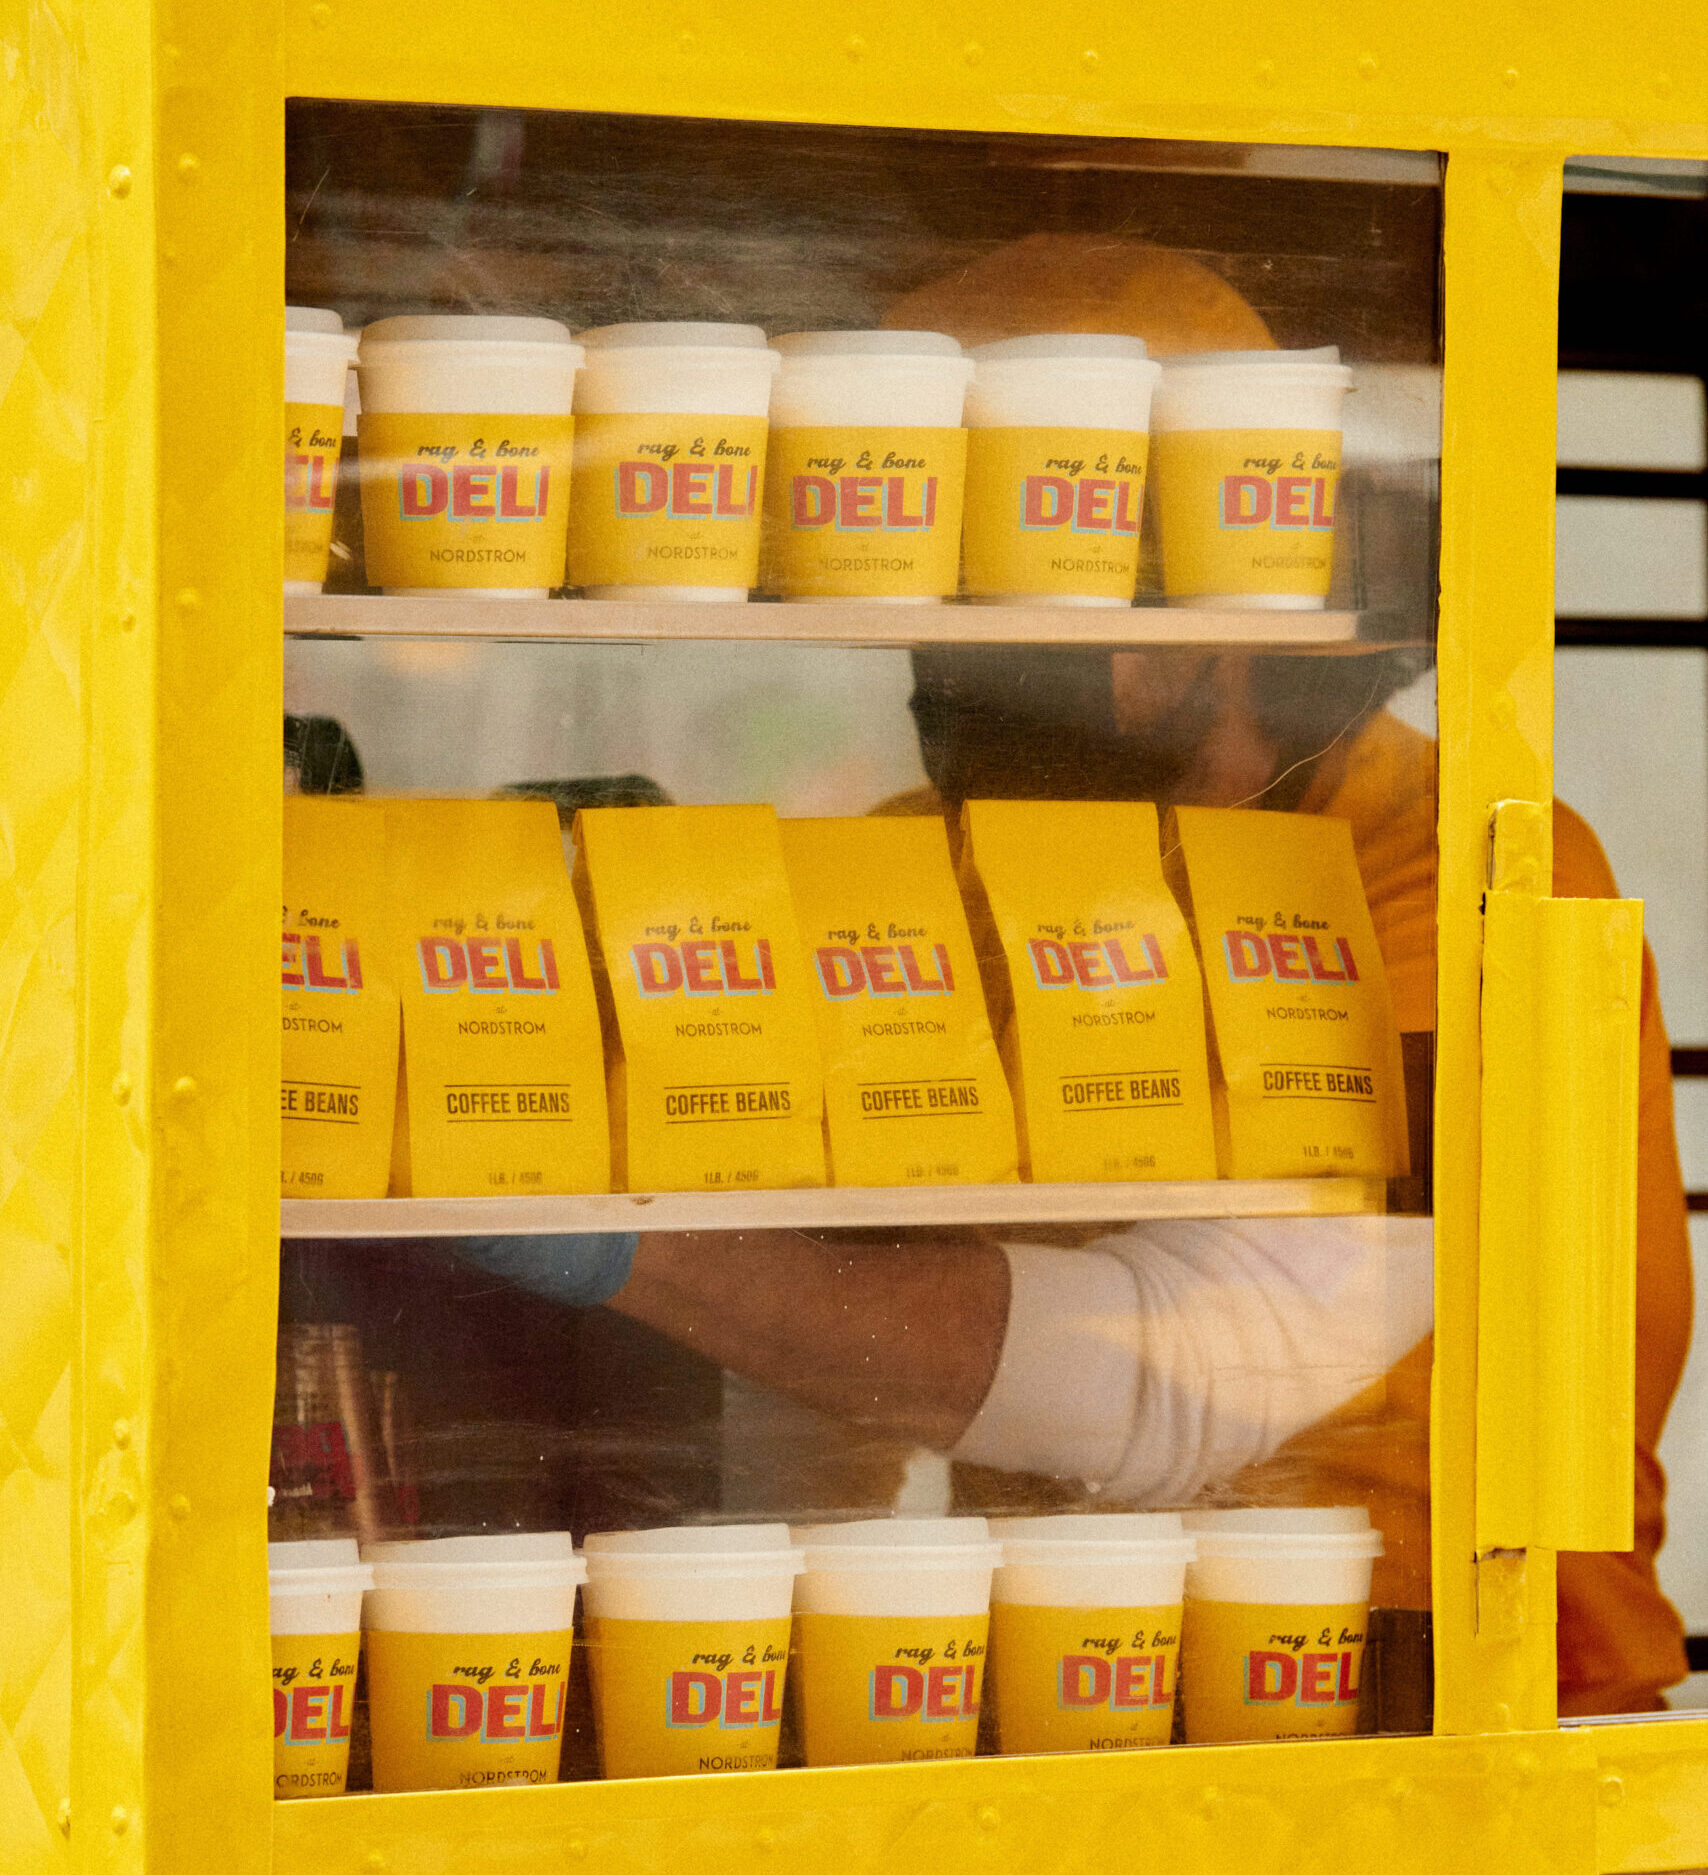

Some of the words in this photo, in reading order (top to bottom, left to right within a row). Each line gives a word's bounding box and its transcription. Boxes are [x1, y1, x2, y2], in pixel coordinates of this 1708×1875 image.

[416, 443, 458, 464] rag
[468, 437, 487, 459] &
[495, 439, 539, 458] bone
[636, 443, 680, 462] rag
[688, 436, 706, 458] &
[806, 456, 847, 476] rag
[855, 450, 873, 470] &
[881, 451, 927, 470] bone
[1045, 457, 1087, 477] rag
[1094, 453, 1109, 474] &
[1242, 456, 1283, 476] rag
[1291, 451, 1306, 471] &
[284, 454, 340, 514] EL
[398, 463, 551, 523] DELI
[614, 461, 758, 520] DELI
[790, 475, 938, 532] DELI
[1019, 475, 1143, 538] DEL
[1218, 475, 1341, 532] DEL
[430, 549, 526, 563] NORDSTROM
[647, 545, 739, 560] NORDSTROM
[1050, 558, 1130, 574] NORDSTROM
[298, 908, 340, 929] bone
[432, 917, 467, 936] rag
[475, 912, 489, 931] &
[496, 913, 536, 931] bone
[643, 924, 681, 942] rag
[688, 916, 703, 936] &
[710, 915, 752, 933] bone
[1036, 923, 1067, 941] rag
[1092, 917, 1135, 936] bone
[1235, 914, 1268, 932] rag
[1273, 911, 1287, 930] &
[1292, 913, 1330, 931] bone
[826, 929, 861, 946] rag
[866, 922, 881, 941] &
[886, 922, 928, 940] bone
[281, 932, 364, 995] ELI
[415, 936, 561, 995] DELI
[628, 938, 777, 1000] DELI
[1026, 933, 1169, 992] DELI
[1221, 930, 1361, 987] DELI
[813, 943, 956, 1002] DELI
[282, 1016, 343, 1034] DSTROM
[457, 1020, 547, 1035] NORDSTROM
[1072, 1010, 1156, 1028] NORDSTROM
[1266, 1006, 1349, 1022] NORDSTROM
[674, 1022, 763, 1038] NORDSTROM
[862, 1020, 947, 1037] NORDSTROM
[1061, 1080, 1126, 1106] COFFEE
[1130, 1077, 1181, 1101] BEANS
[1263, 1069, 1323, 1092] COFFEE
[1327, 1072, 1374, 1096] BEANS
[304, 1090, 360, 1116] BEANS
[446, 1092, 511, 1114] COFFEE
[517, 1091, 570, 1114] BEANS
[665, 1092, 730, 1117] COFFEE
[736, 1089, 792, 1113] BEANS
[861, 1087, 923, 1112] COFFEE
[928, 1085, 980, 1109] BEANS
[894, 1646, 936, 1666] rag
[943, 1639, 958, 1660] &
[1081, 1636, 1123, 1656] rag
[1130, 1629, 1146, 1650] &
[1268, 1632, 1310, 1652] rag
[1317, 1626, 1332, 1647] &
[272, 1665, 300, 1686] ag
[308, 1657, 324, 1680] &
[452, 1665, 496, 1686] rag
[503, 1657, 521, 1680] &
[691, 1652, 734, 1672] rag
[741, 1645, 756, 1666] &
[1057, 1653, 1173, 1712] DEL
[1243, 1650, 1360, 1708] DEL
[665, 1669, 784, 1730] DEL
[869, 1664, 981, 1723] DEL
[273, 1682, 357, 1747] EL
[425, 1681, 566, 1744] DELI
[1089, 1737, 1168, 1750] NORDST
[274, 1771, 342, 1789] ORDSTRO
